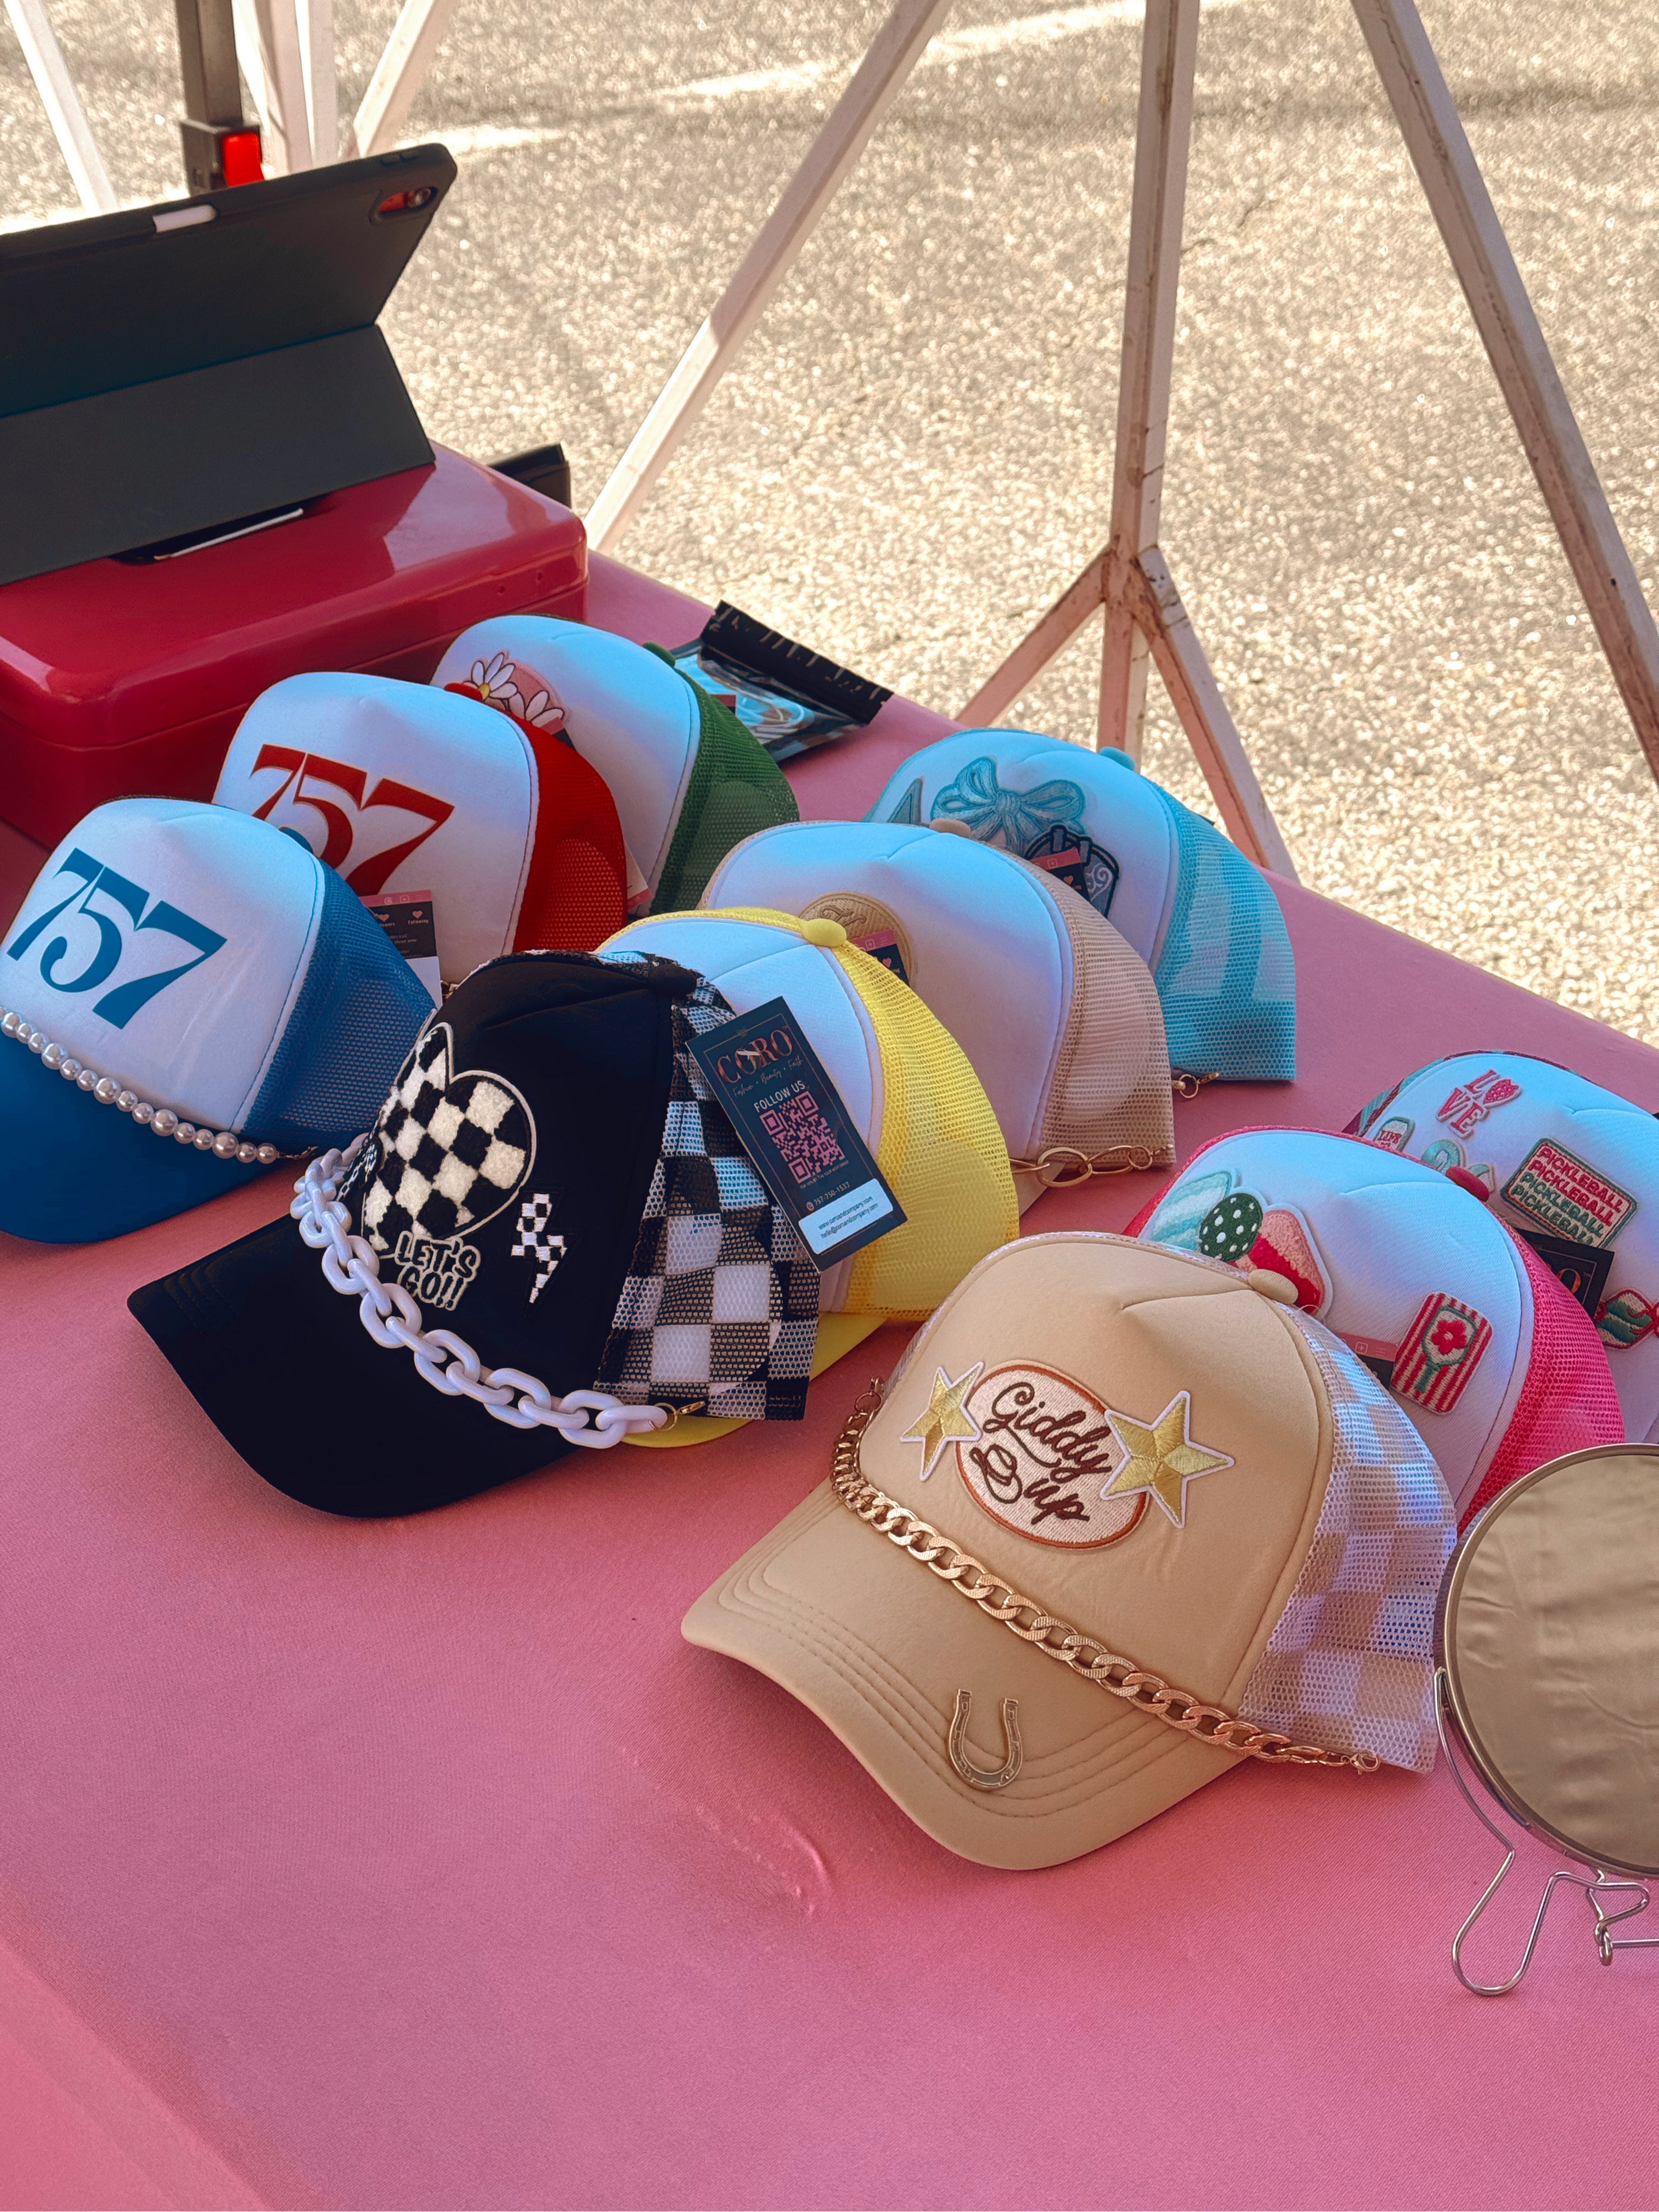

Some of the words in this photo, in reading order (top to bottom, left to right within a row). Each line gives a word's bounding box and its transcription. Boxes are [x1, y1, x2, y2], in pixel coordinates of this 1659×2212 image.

[250, 743, 455, 895] 757
[7, 848, 227, 1030] 757
[754, 1086, 791, 1113] FOLLOW
[791, 1080, 806, 1093] US
[1520, 1171, 1605, 1239] PICKLEBALL
[1528, 1159, 1614, 1227] PICKLEBALL
[1537, 1147, 1623, 1214] PICKLEBALL
[397, 1234, 477, 1279] LET'S
[983, 1380, 1113, 1484] Giddy
[1023, 1479, 1091, 1525] up
